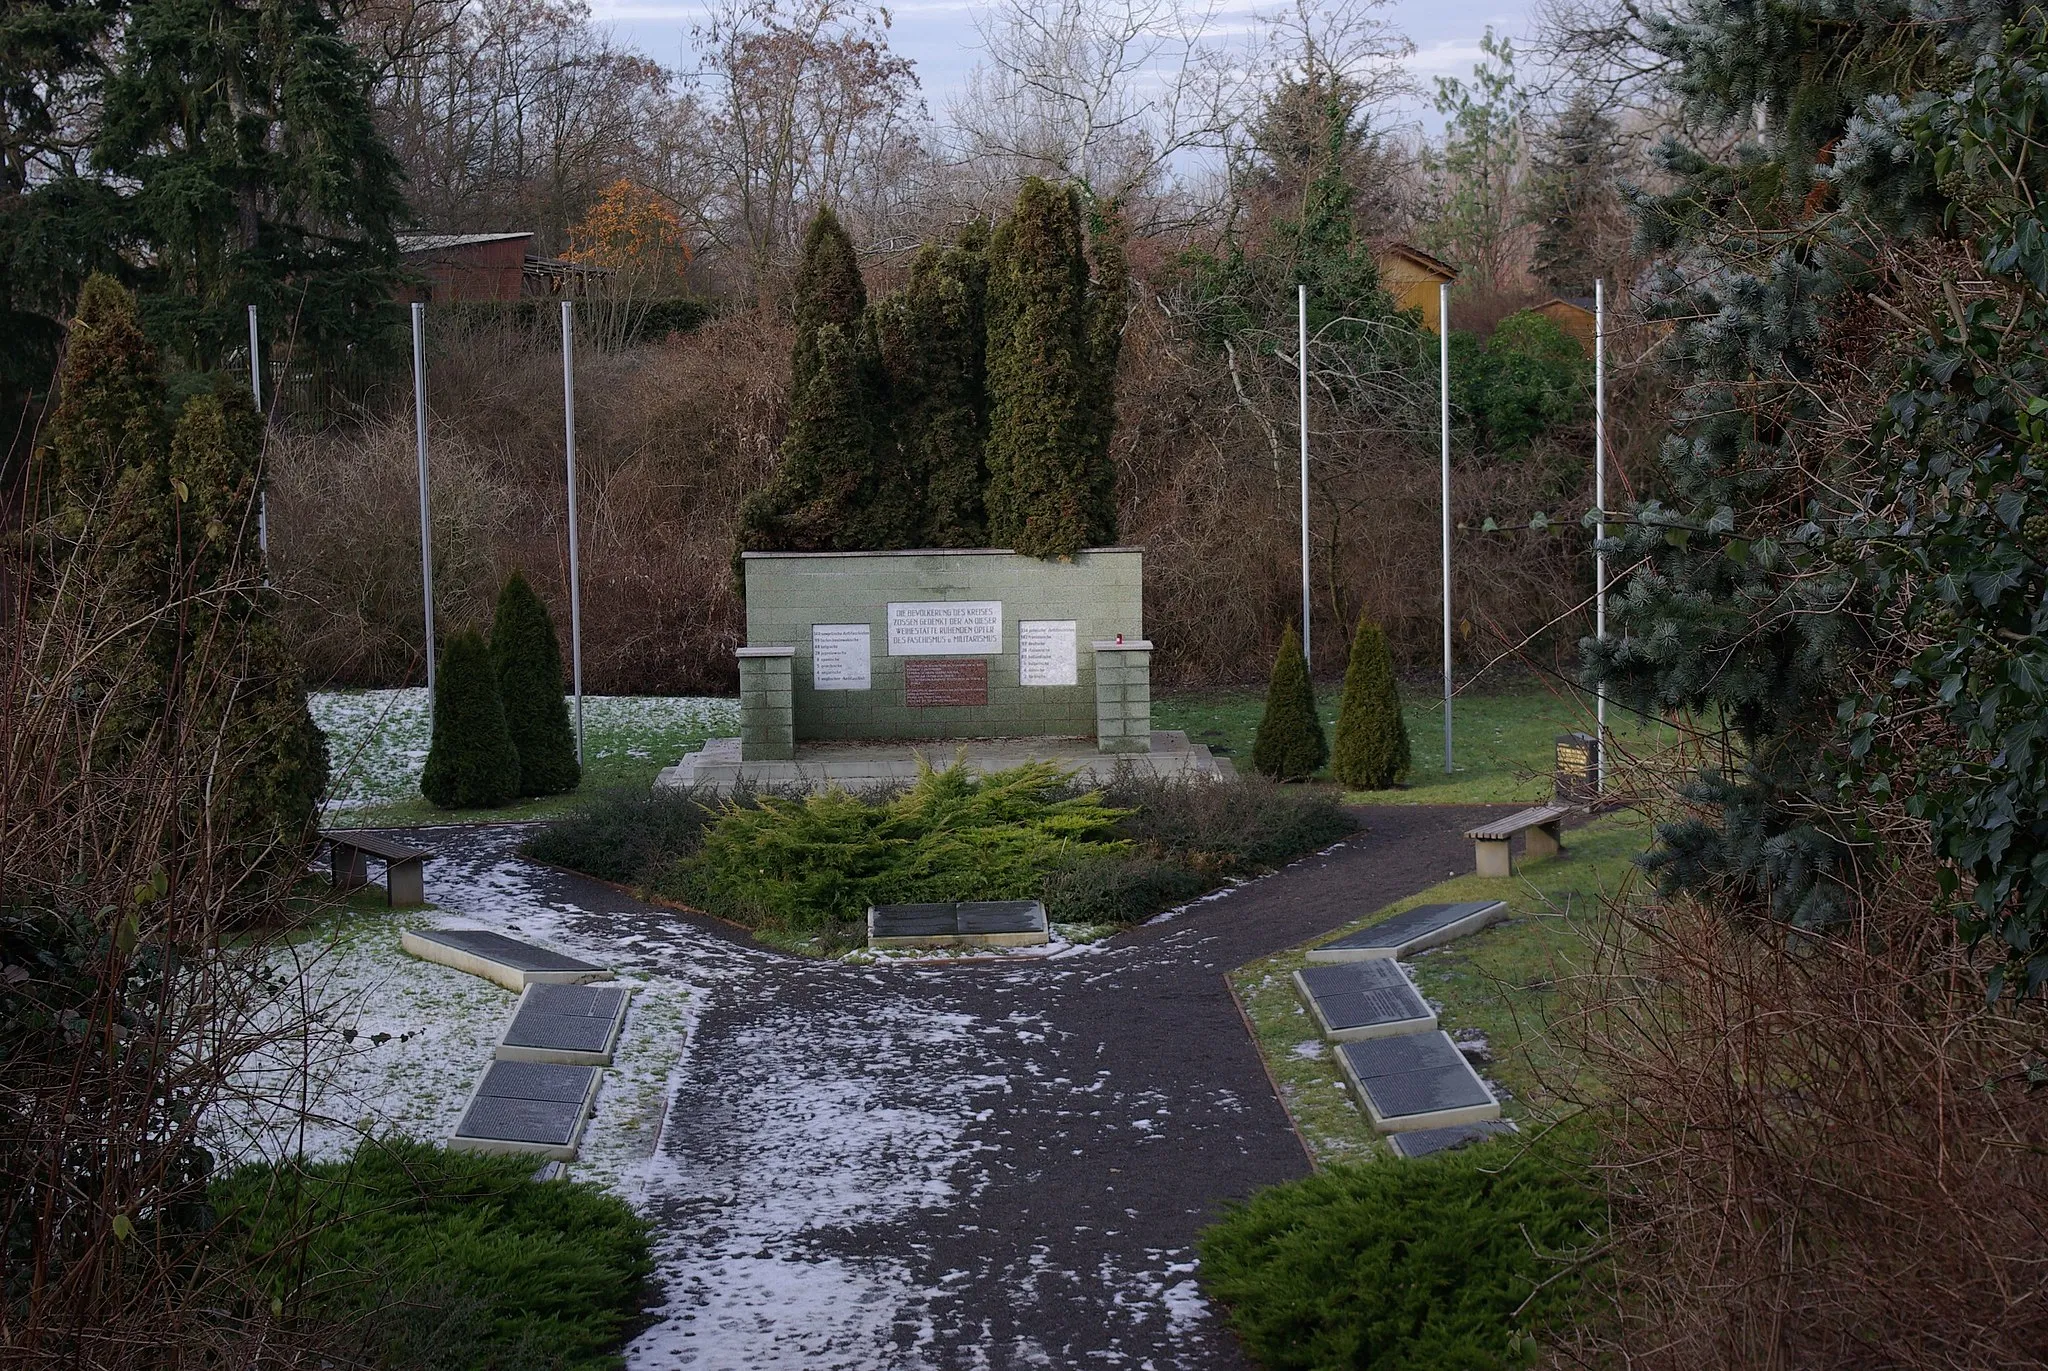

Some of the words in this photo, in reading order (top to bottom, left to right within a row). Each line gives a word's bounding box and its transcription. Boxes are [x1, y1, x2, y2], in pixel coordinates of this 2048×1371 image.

[919, 617, 947, 626] GEDENKT
[949, 617, 962, 625] DER
[964, 617, 973, 625] AN
